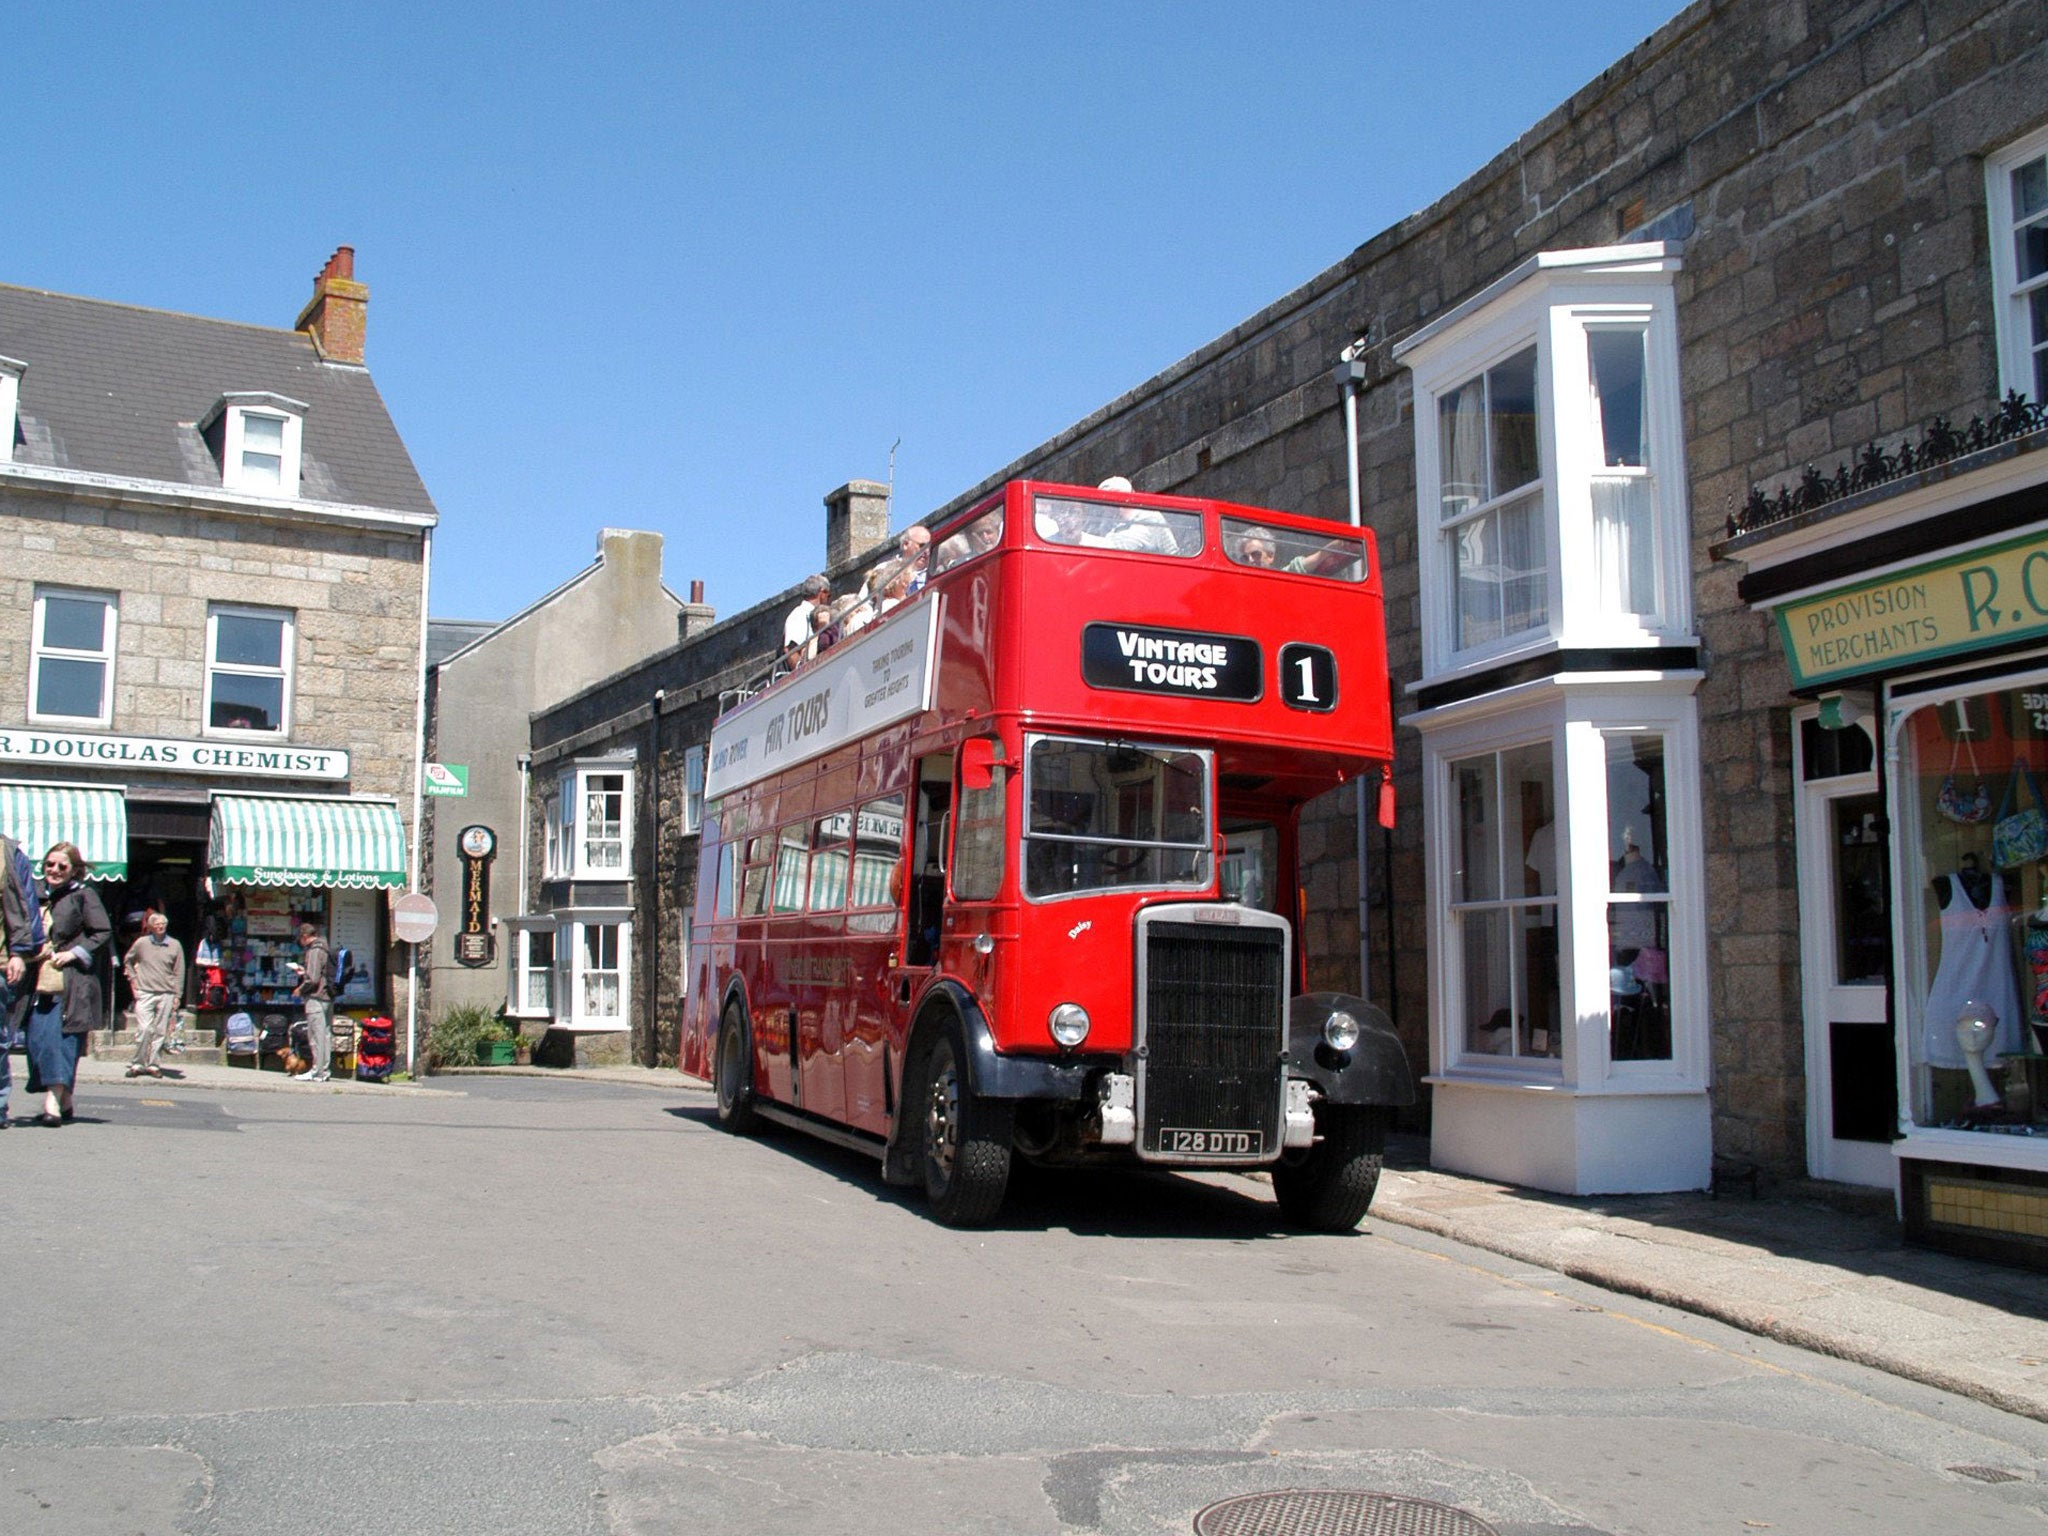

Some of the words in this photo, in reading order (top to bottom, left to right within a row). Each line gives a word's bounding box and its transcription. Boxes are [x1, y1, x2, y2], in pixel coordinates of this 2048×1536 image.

[1807, 584, 1928, 638] PROVISION
[1116, 630, 1227, 666] VINTAGE
[1809, 616, 1939, 669] MERCHANTS
[872, 651, 890, 673] TAKING
[883, 667, 891, 683] TO
[1129, 659, 1218, 692] TOURS
[1294, 655, 1320, 703] 1
[864, 685, 887, 708] GREATER
[887, 674, 910, 698] HEIGHTS
[764, 717, 784, 758] AIR
[787, 687, 832, 745] TOURS
[29, 738, 178, 763] DOUGLAS
[192, 748, 331, 772] CHEMIST
[428, 785, 465, 796] FUJIFILM
[254, 867, 317, 883] Sunglasses
[323, 870, 332, 881] &
[338, 869, 381, 884] Lotions
[468, 860, 483, 933] MERMAID
[1067, 919, 1093, 940] Daisy
[1173, 1131, 1205, 1152] 128
[1209, 1132, 1249, 1154] DTD
